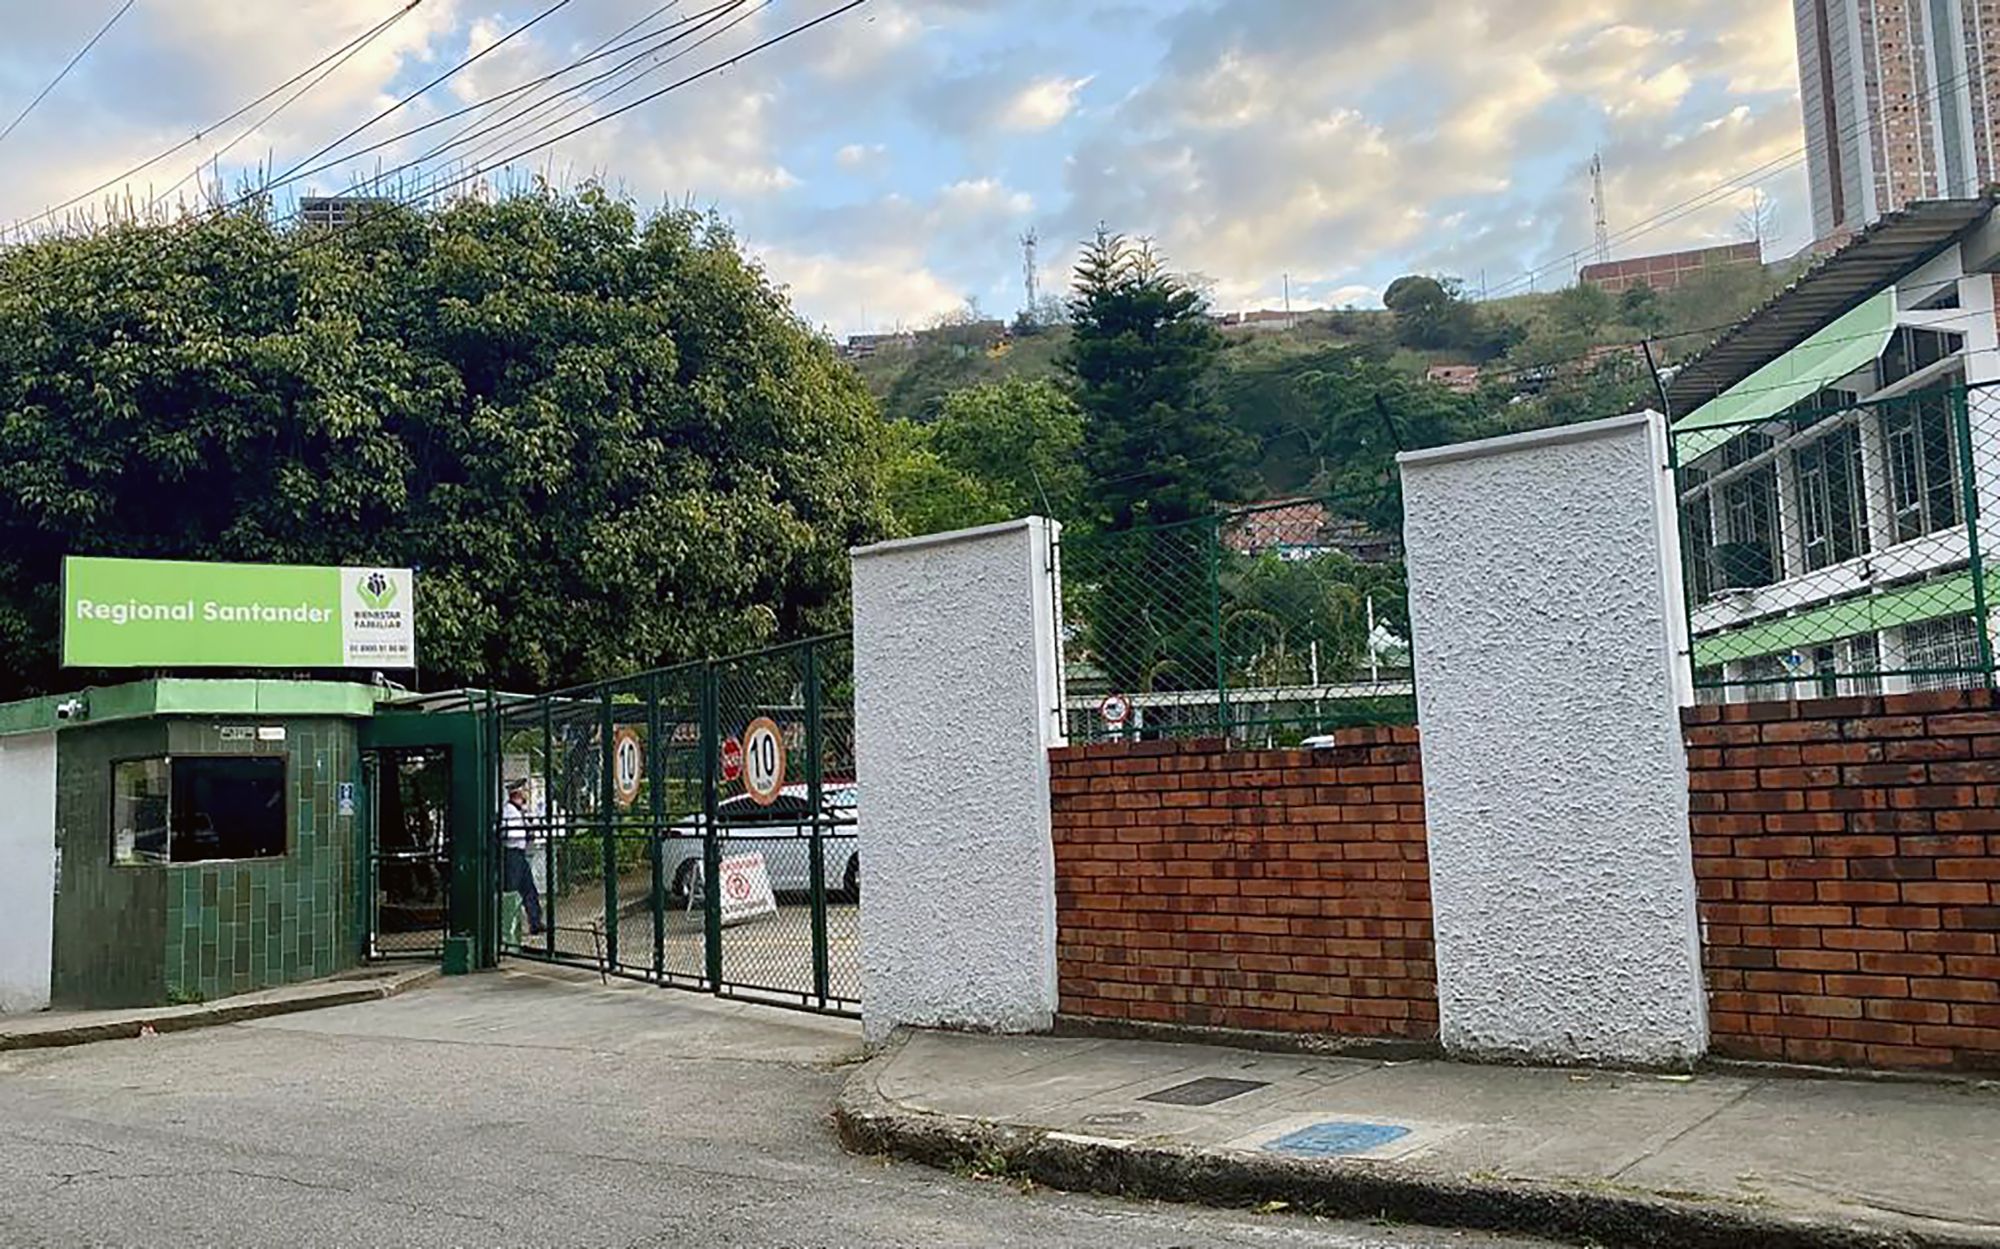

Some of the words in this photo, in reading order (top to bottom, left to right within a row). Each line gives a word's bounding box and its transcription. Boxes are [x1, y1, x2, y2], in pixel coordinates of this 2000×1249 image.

[76, 599, 193, 624] Regional
[203, 601, 332, 622] Santander
[354, 620, 401, 629] FAMILIAR
[620, 744, 636, 780] 10
[751, 734, 774, 778] 10
